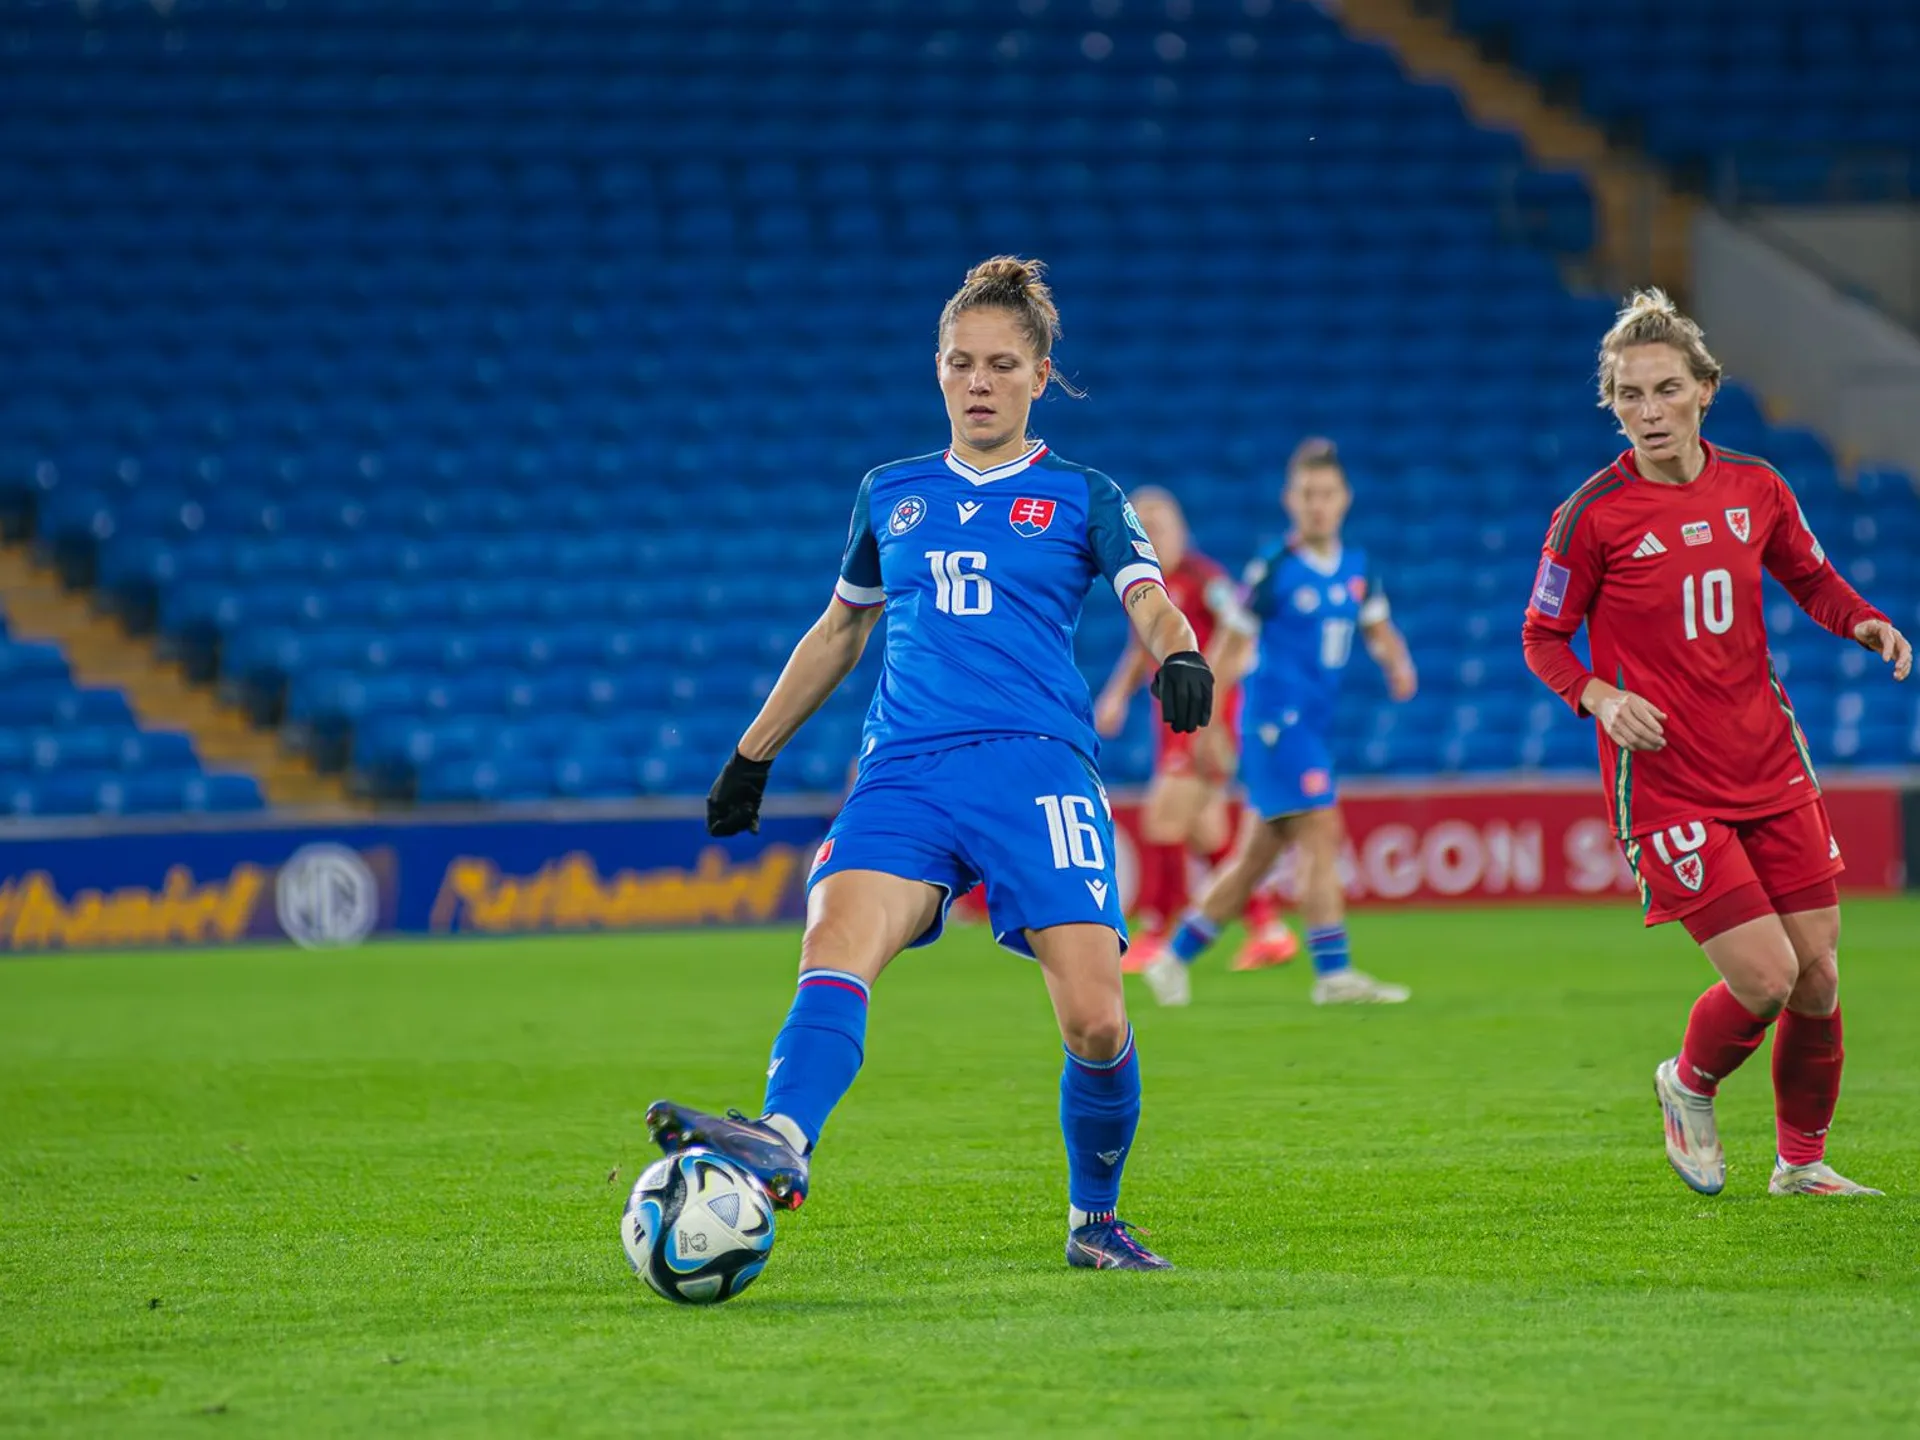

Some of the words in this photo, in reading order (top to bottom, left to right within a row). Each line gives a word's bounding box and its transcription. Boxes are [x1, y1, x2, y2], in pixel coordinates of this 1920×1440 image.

[924, 550, 993, 616] 16
[1682, 568, 1735, 641] 10
[1035, 794, 1105, 870] 16
